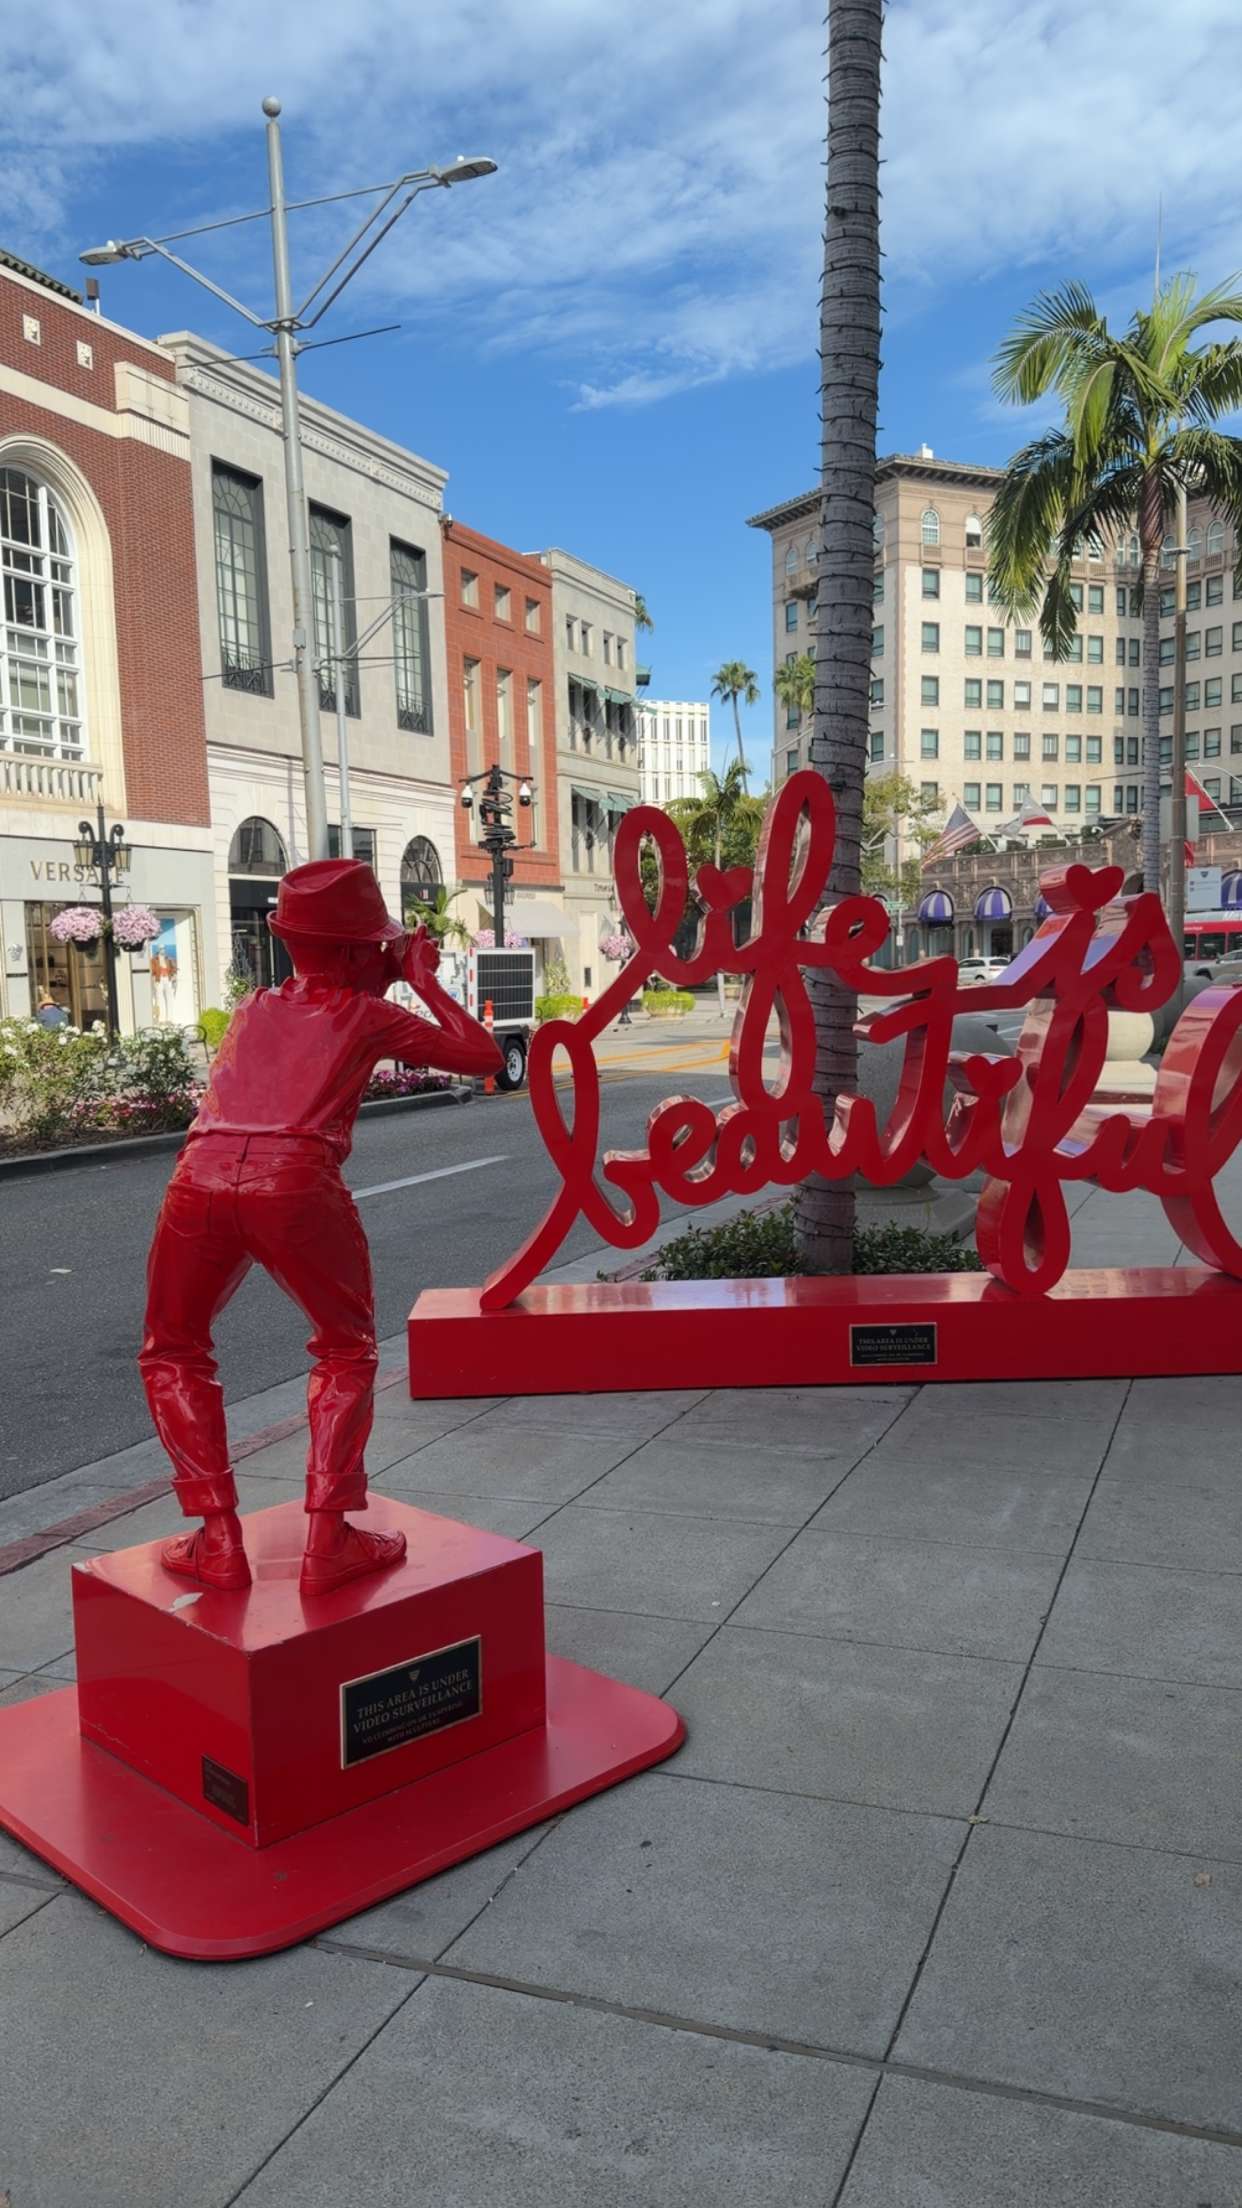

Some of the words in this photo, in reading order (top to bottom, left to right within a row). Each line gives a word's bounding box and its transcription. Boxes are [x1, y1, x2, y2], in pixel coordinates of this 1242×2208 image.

[30, 860, 124, 884] VERSAE
[352, 1712, 390, 1733] VIDEO
[391, 1680, 473, 1720] SURVEILLANCE
[357, 1700, 384, 1719] THIS
[387, 1688, 416, 1708] AREA
[419, 1684, 430, 1695] IS
[431, 1669, 469, 1690] UNDER
